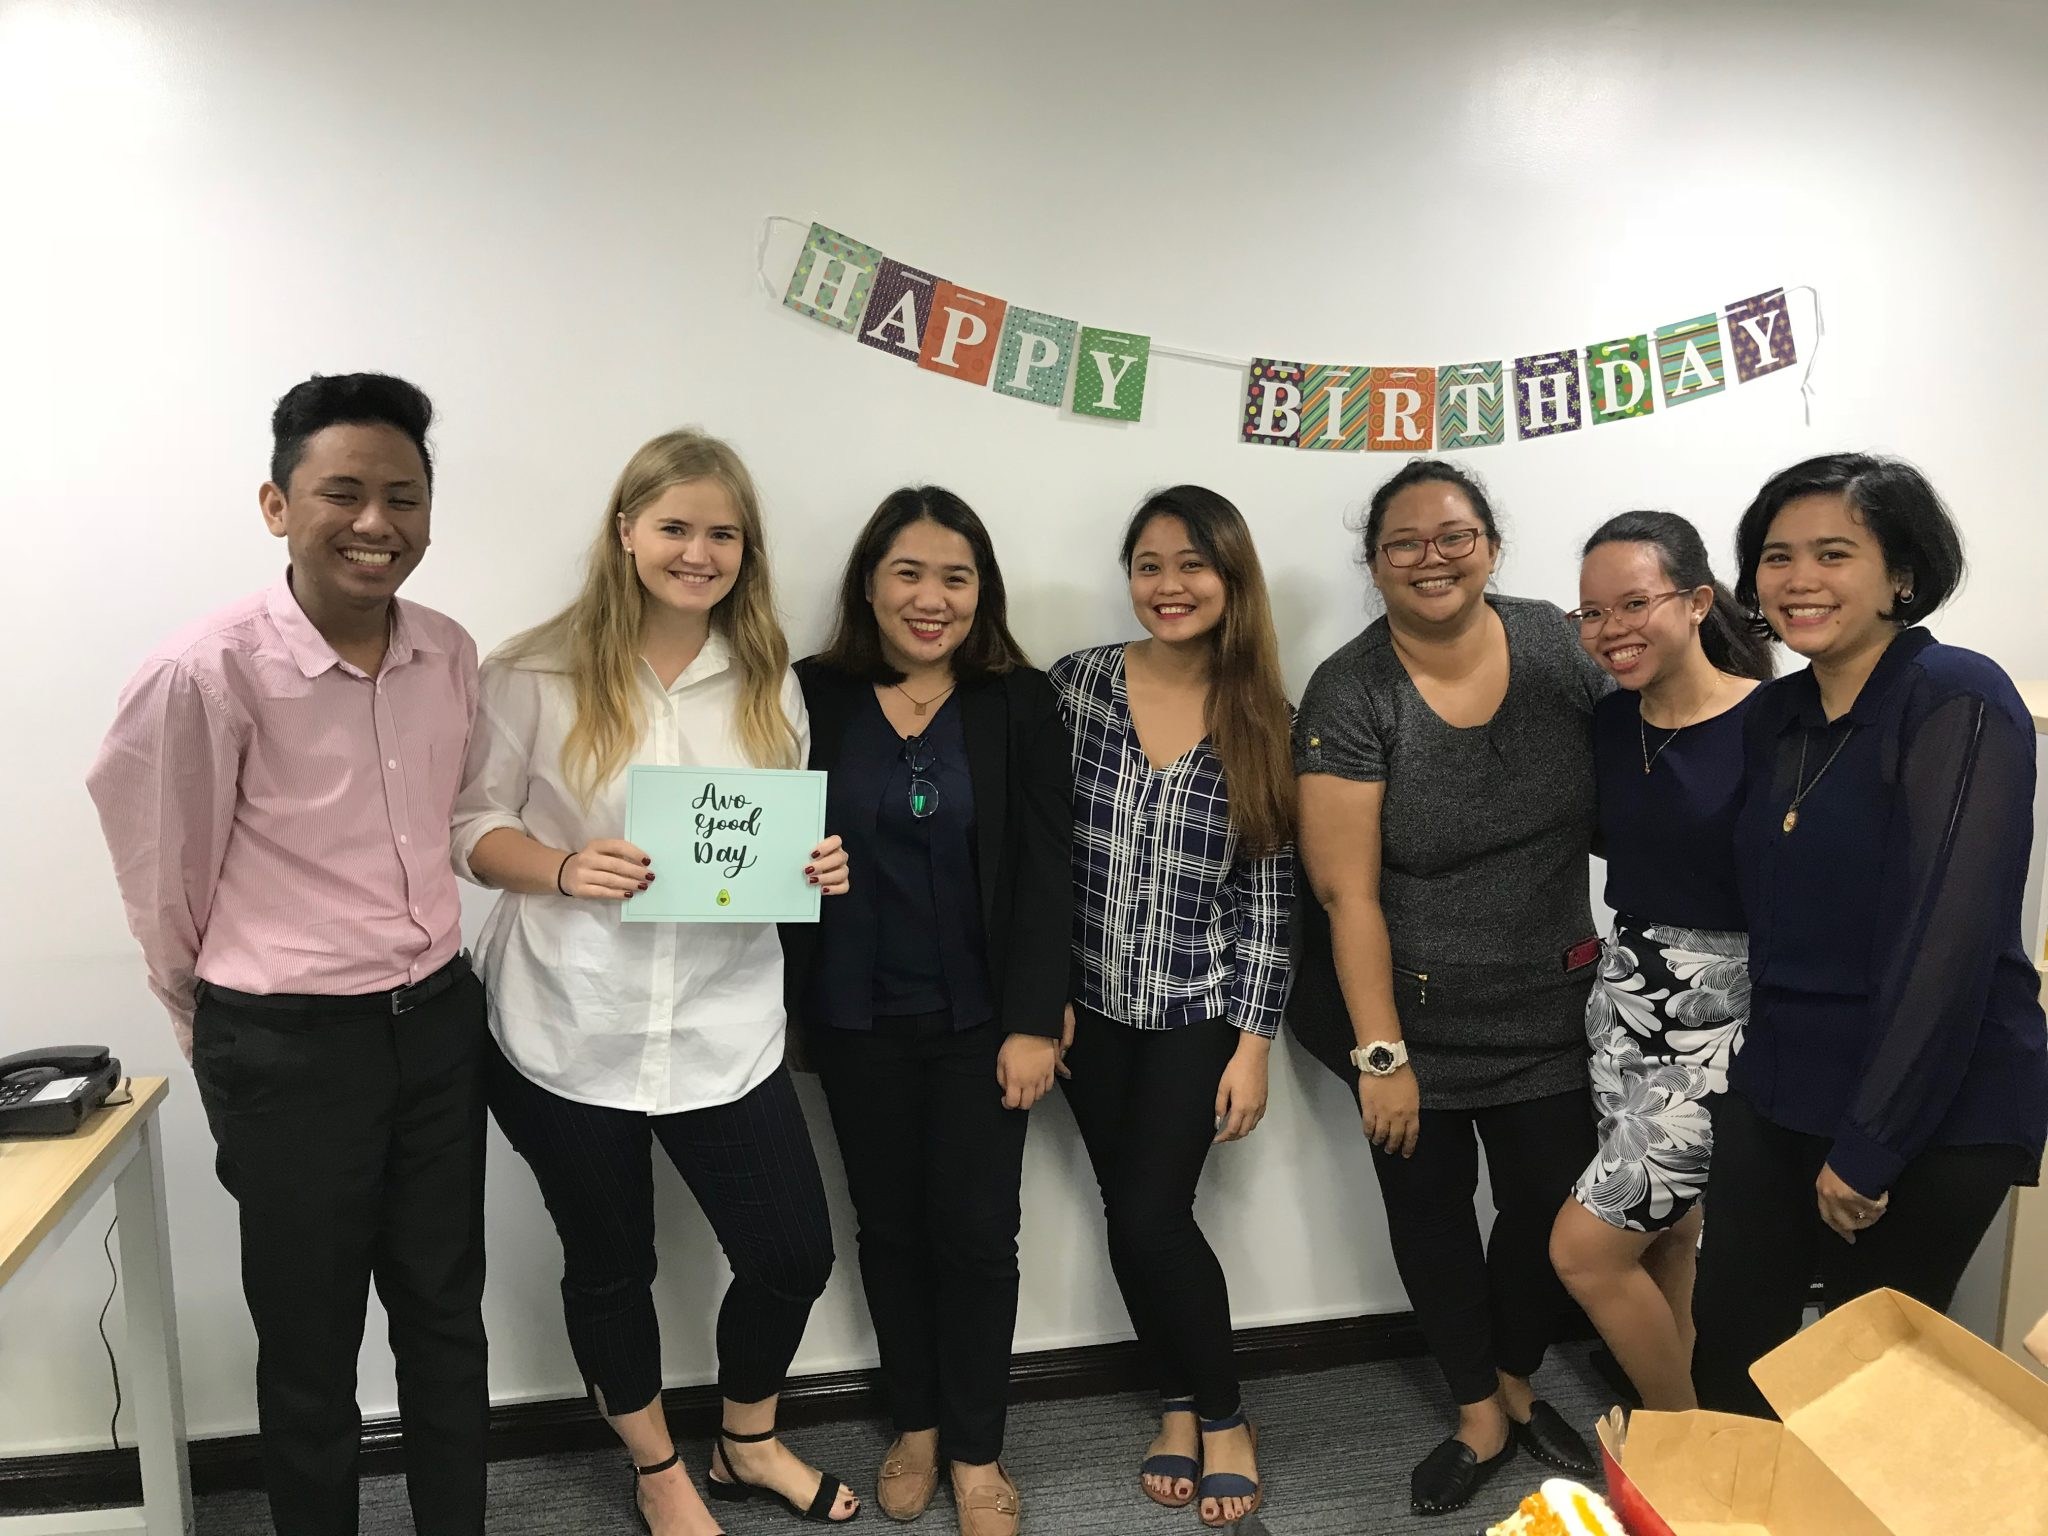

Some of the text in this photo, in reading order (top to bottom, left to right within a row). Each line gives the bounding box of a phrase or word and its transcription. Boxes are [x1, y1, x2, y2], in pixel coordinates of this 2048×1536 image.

[795, 246, 1780, 442] HAPPY BIRTHDAY
[692, 782, 752, 811] Avo
[694, 841, 758, 879] Day
